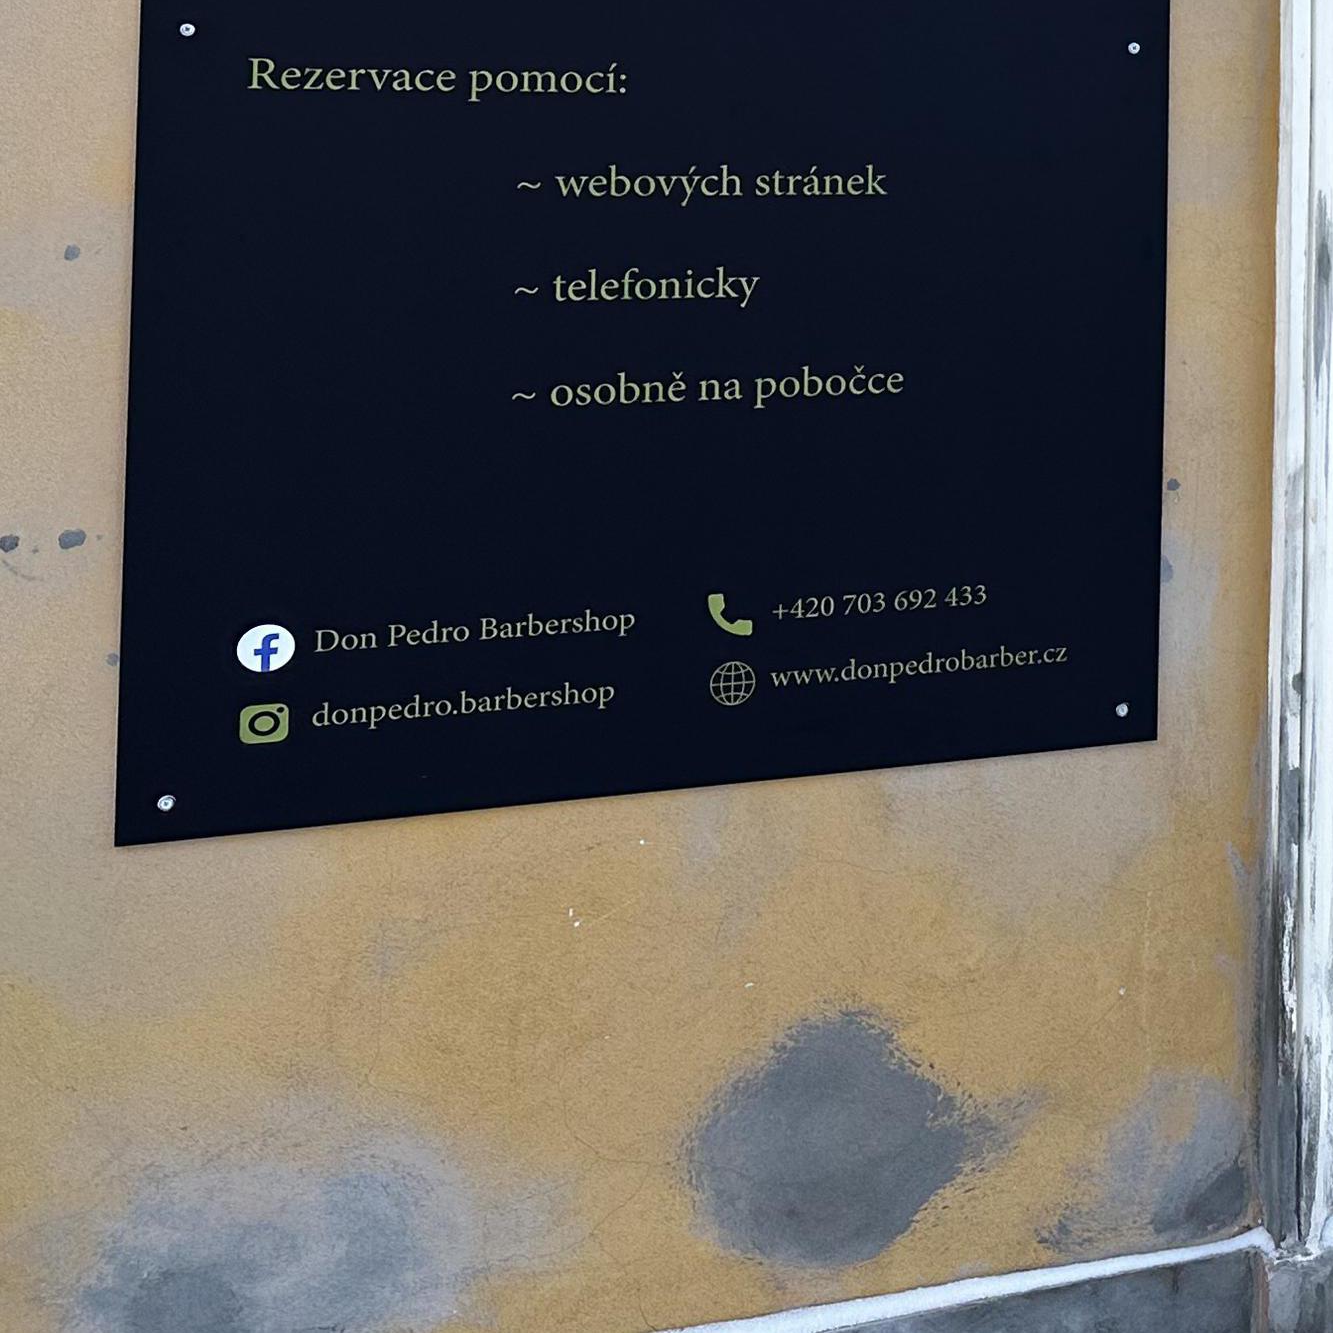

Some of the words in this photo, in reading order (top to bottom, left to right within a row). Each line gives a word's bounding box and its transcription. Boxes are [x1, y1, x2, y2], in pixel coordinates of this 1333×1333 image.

[248, 57, 457, 93] Rezervace
[468, 62, 628, 103] pomocí:
[555, 163, 744, 207] webových
[755, 163, 889, 198] stránek
[552, 265, 761, 309] telefonicky
[550, 371, 688, 408] osobně
[697, 379, 744, 403] na
[753, 365, 905, 410] pobočce
[772, 595, 836, 621] +420
[842, 591, 887, 616] 703
[893, 587, 938, 613] 692
[944, 583, 988, 607] 433
[314, 625, 378, 654] Don
[387, 618, 470, 650] Pedro
[480, 608, 637, 643] Barbershop
[770, 642, 1069, 689] www.donpedrobarber.cz
[311, 681, 616, 731] donpedro.barbershop
